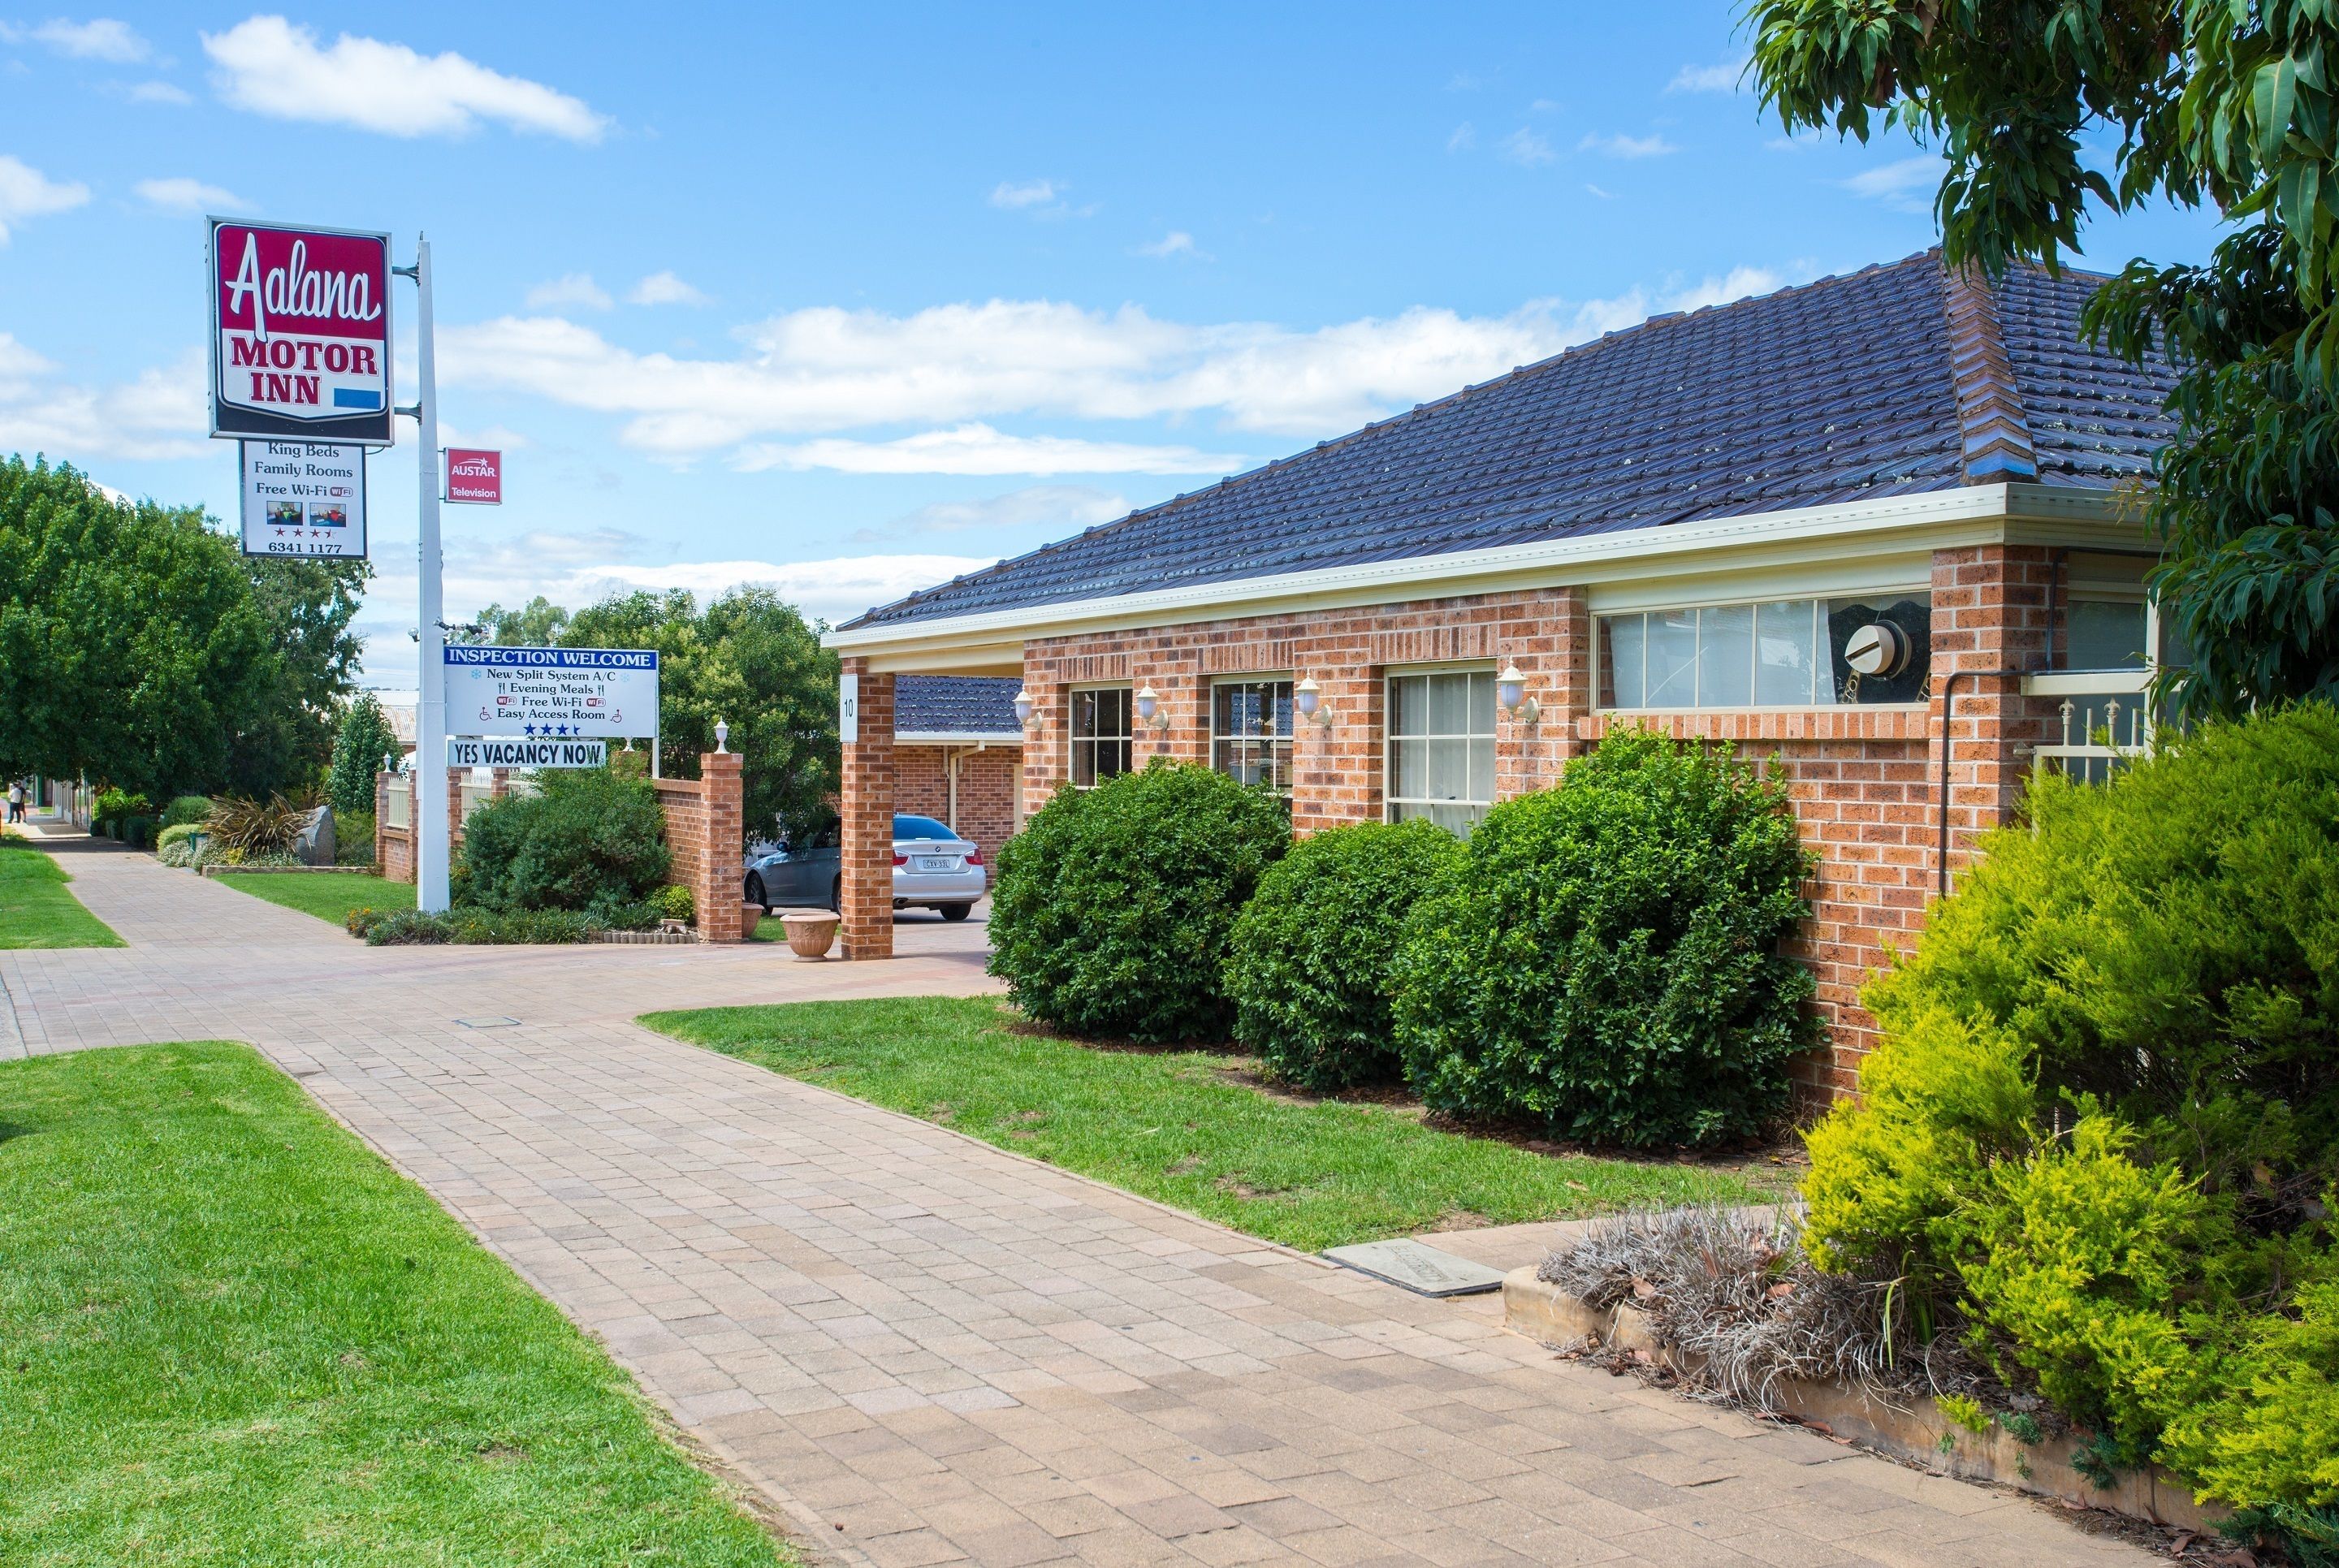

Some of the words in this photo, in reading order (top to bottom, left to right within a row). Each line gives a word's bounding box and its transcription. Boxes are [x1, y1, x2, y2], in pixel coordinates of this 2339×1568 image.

[224, 231, 382, 343] Aalana
[231, 335, 378, 376] MOTOR
[249, 370, 321, 406] INN
[268, 442, 301, 458] King
[305, 444, 339, 458] Beds
[255, 461, 301, 477] Family
[305, 464, 353, 477] Rooms
[452, 465, 495, 477] AUSTAR
[256, 482, 287, 495] Free
[292, 484, 327, 496] Wi-Fi
[452, 487, 496, 498] Television
[268, 542, 303, 553] 6341
[309, 543, 342, 554] 1177
[449, 649, 559, 664] INSPECTION
[563, 652, 651, 667] WELCOME
[487, 668, 512, 679] New
[516, 669, 544, 681] Split
[547, 670, 590, 682] System
[593, 672, 616, 682] A/C
[510, 683, 557, 695] Evening
[560, 684, 594, 694] Meals
[521, 696, 548, 706] Free
[552, 697, 582, 706] Wi-Fi
[845, 698, 854, 718] 10
[497, 708, 525, 720] Easy
[528, 709, 569, 719] Access
[572, 709, 605, 719] Room
[455, 744, 478, 764] YES
[482, 744, 560, 764] VACANCY
[563, 745, 601, 764] NOW
